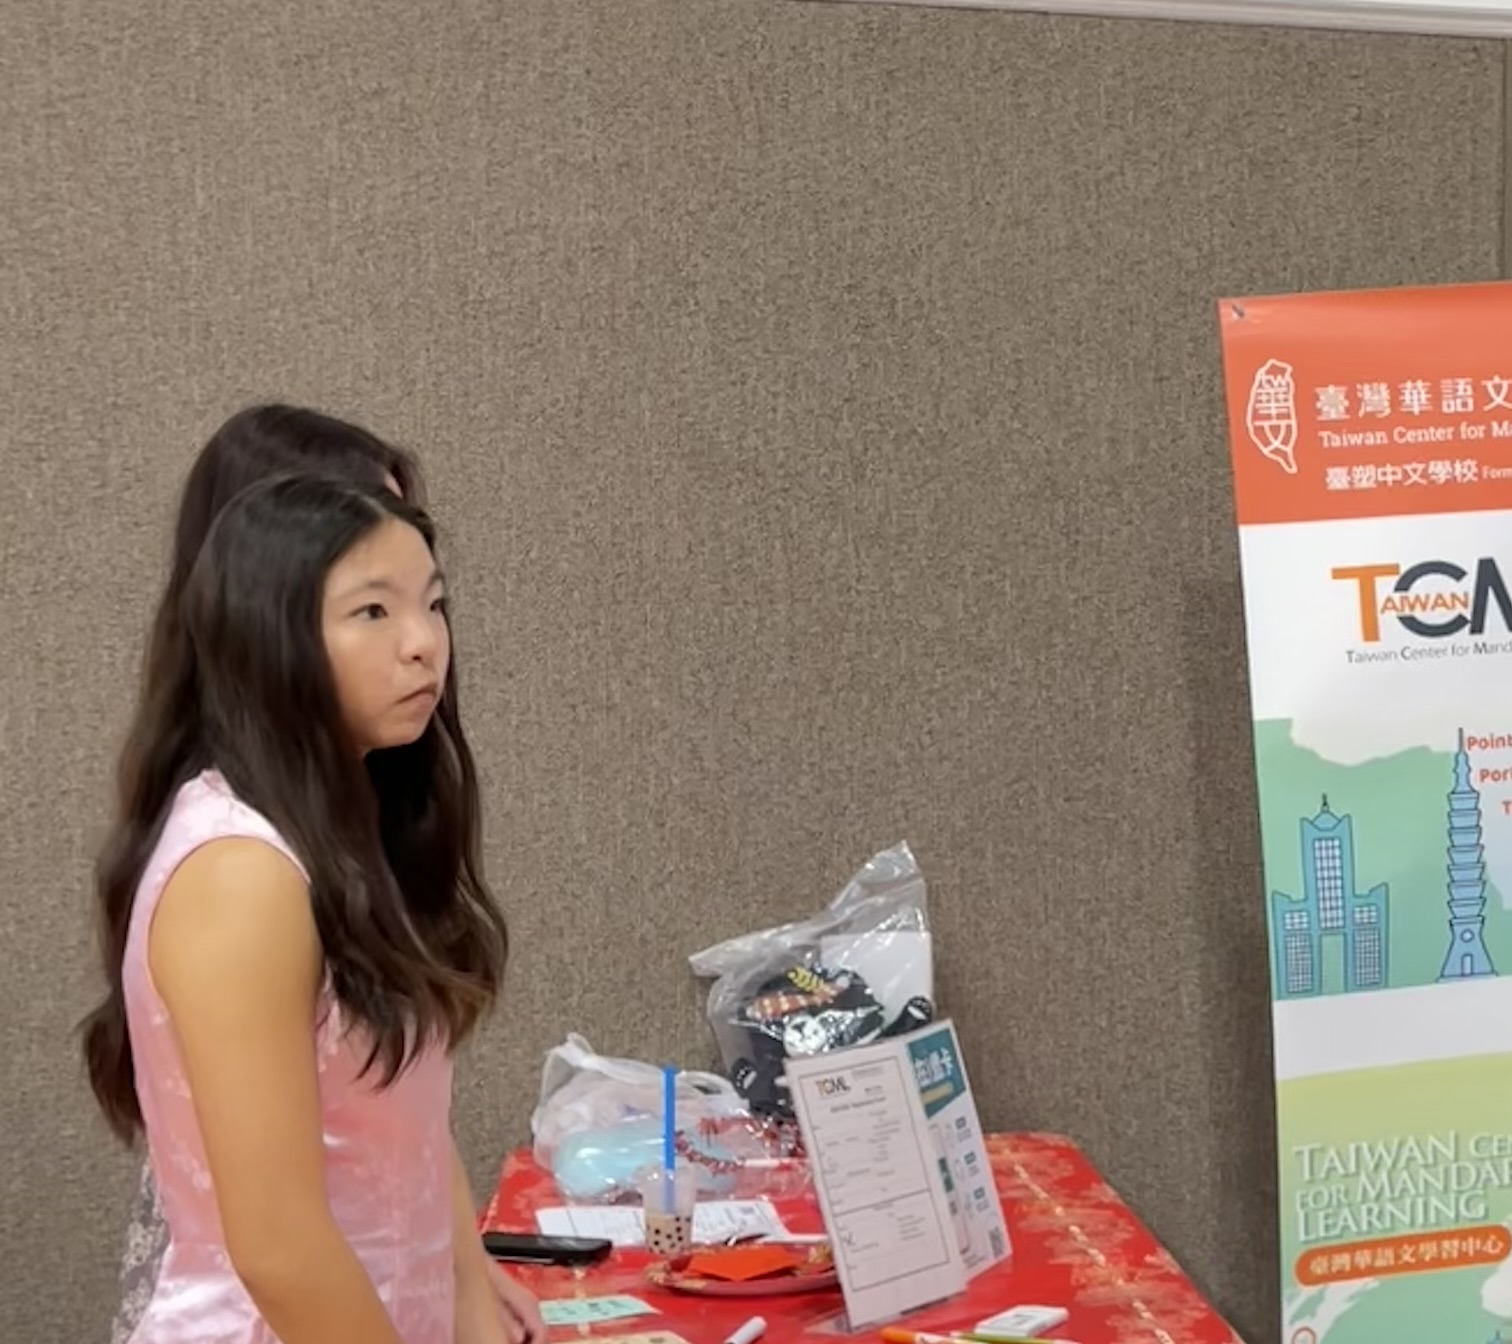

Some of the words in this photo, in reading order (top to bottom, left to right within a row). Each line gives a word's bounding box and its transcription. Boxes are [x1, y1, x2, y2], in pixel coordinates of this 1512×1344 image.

[1318, 429, 1388, 448] Taiwan
[1393, 425, 1455, 443] Center
[1460, 421, 1486, 440] for
[1325, 459, 1478, 490] 臺塑中文學校
[1346, 649, 1397, 664] Taiwan
[1400, 645, 1448, 661] Center
[1451, 643, 1470, 657] for
[1293, 1130, 1458, 1182] TAIWAN
[1297, 1183, 1349, 1212] FOR
[1298, 1189, 1488, 1242] LEARNING
